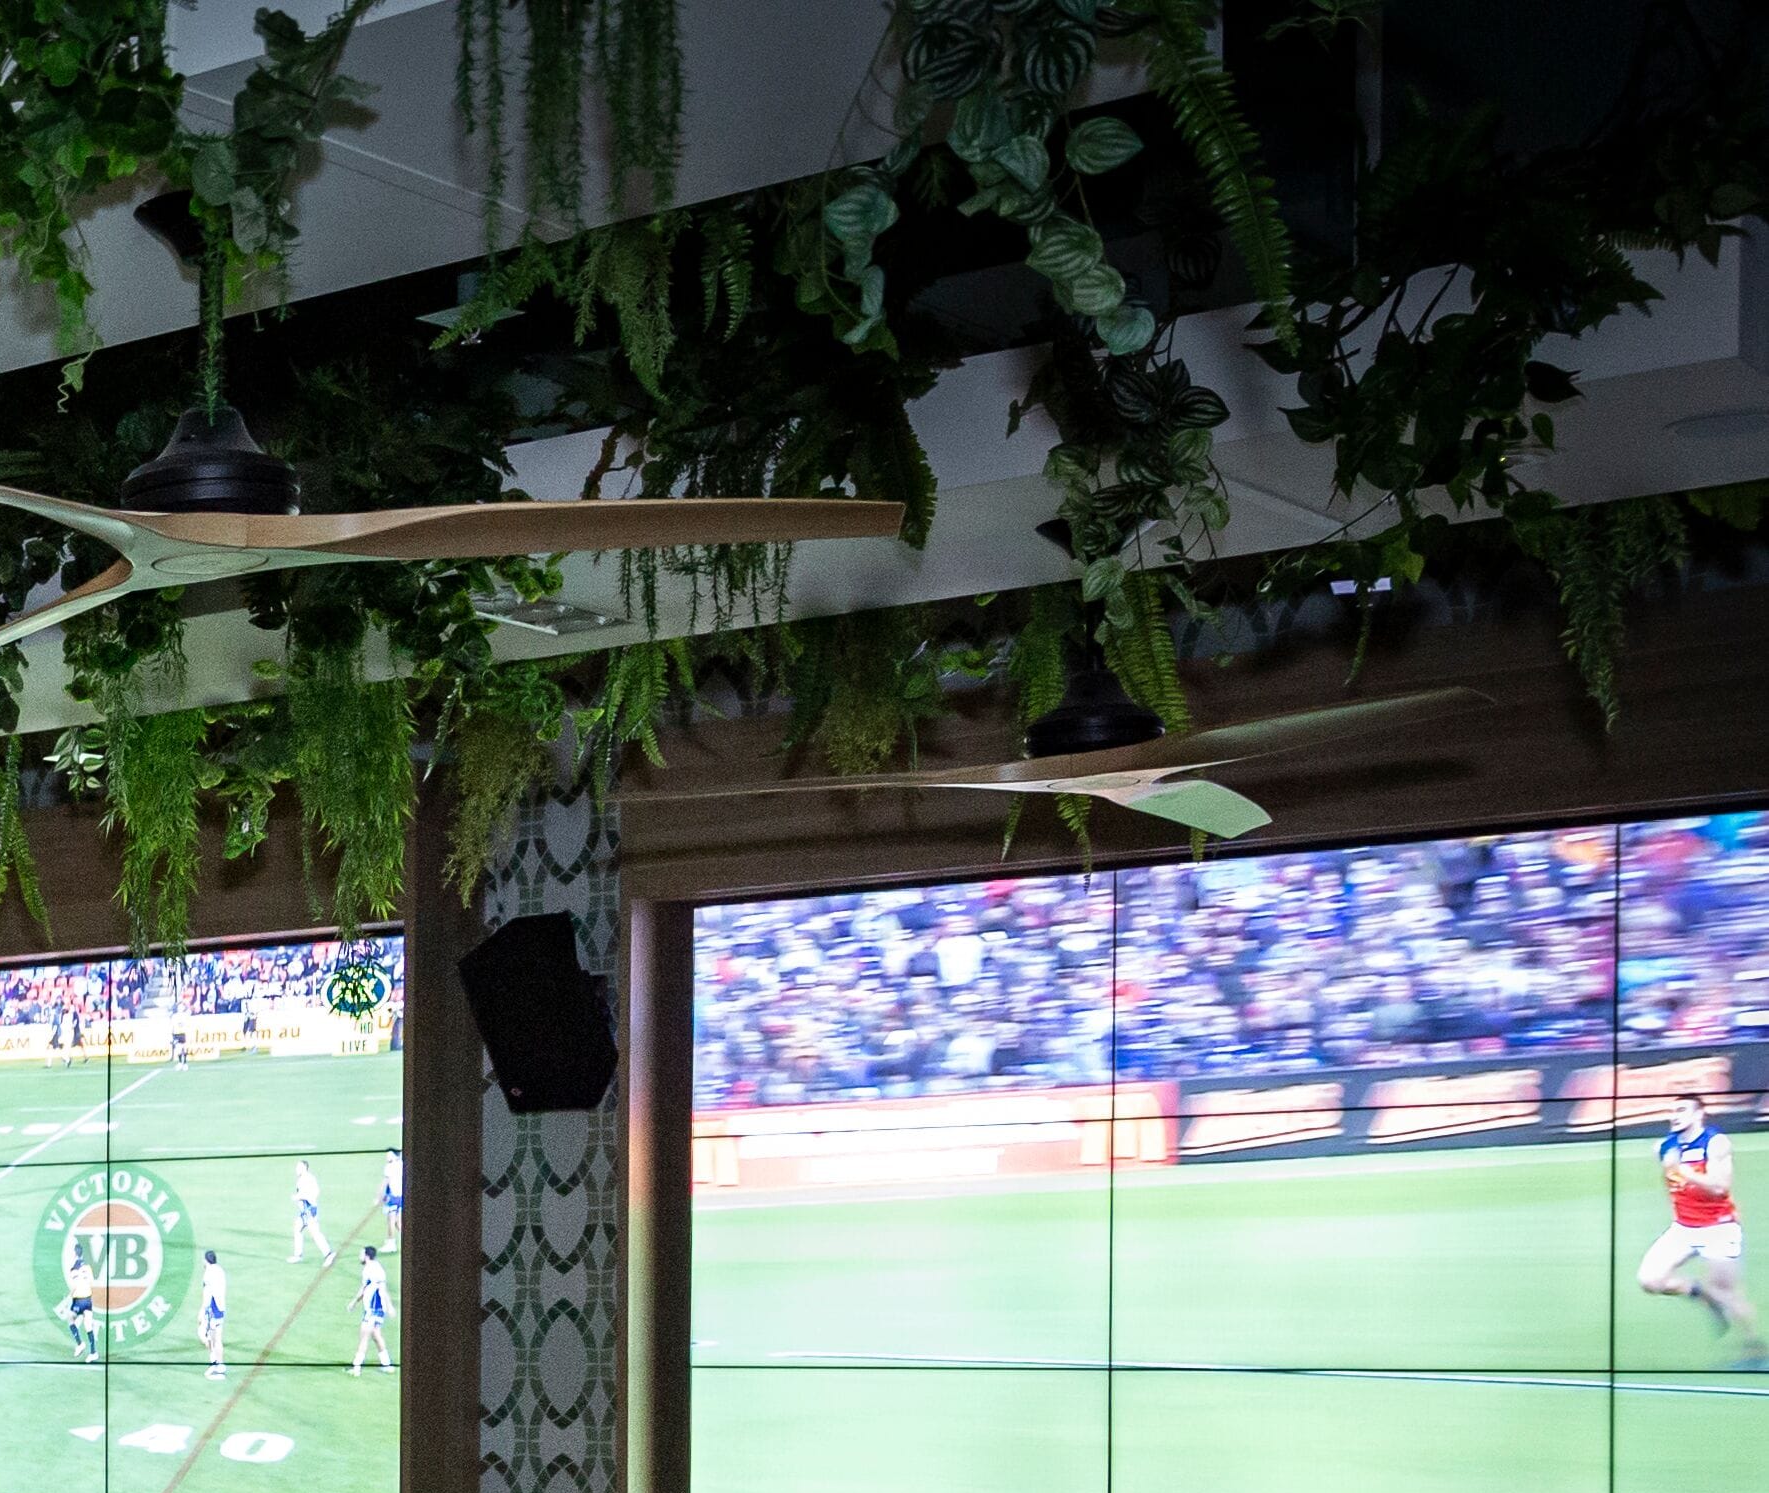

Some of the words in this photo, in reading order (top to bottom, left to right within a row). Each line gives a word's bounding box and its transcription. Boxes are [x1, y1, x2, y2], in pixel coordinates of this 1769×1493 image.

[44, 1170, 181, 1234] VICTORIA
[74, 1233, 149, 1281] VB
[52, 1294, 172, 1343] BTTER
